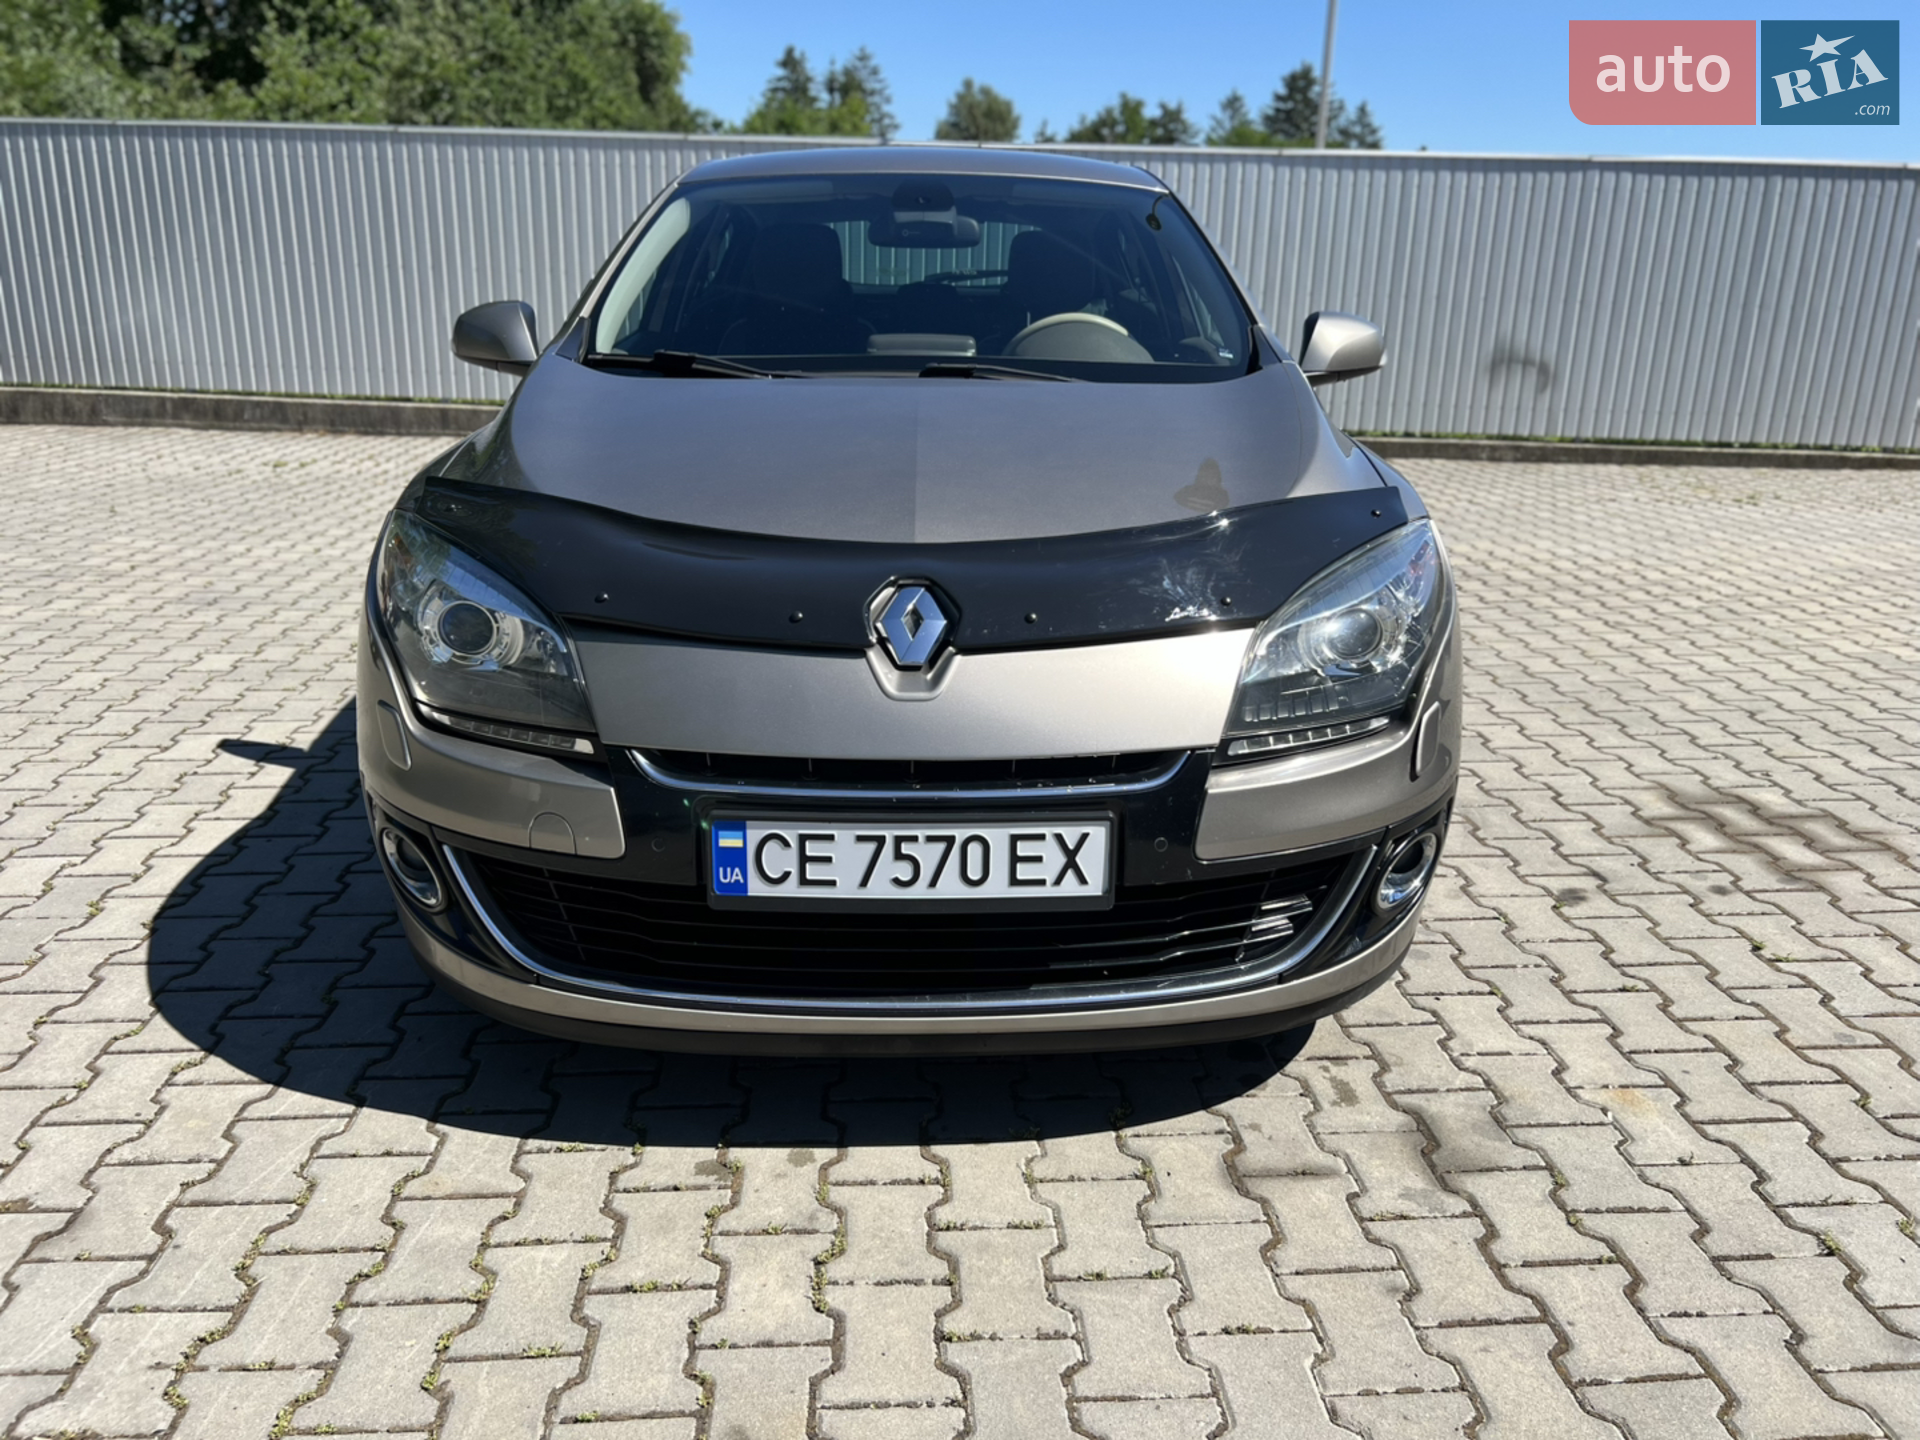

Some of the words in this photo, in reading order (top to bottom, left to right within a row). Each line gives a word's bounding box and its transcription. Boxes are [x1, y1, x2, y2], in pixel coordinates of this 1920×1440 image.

[719, 867, 744, 883] UA
[754, 832, 838, 887] CE
[855, 834, 991, 888] 7570
[1009, 832, 1090, 886] EX
